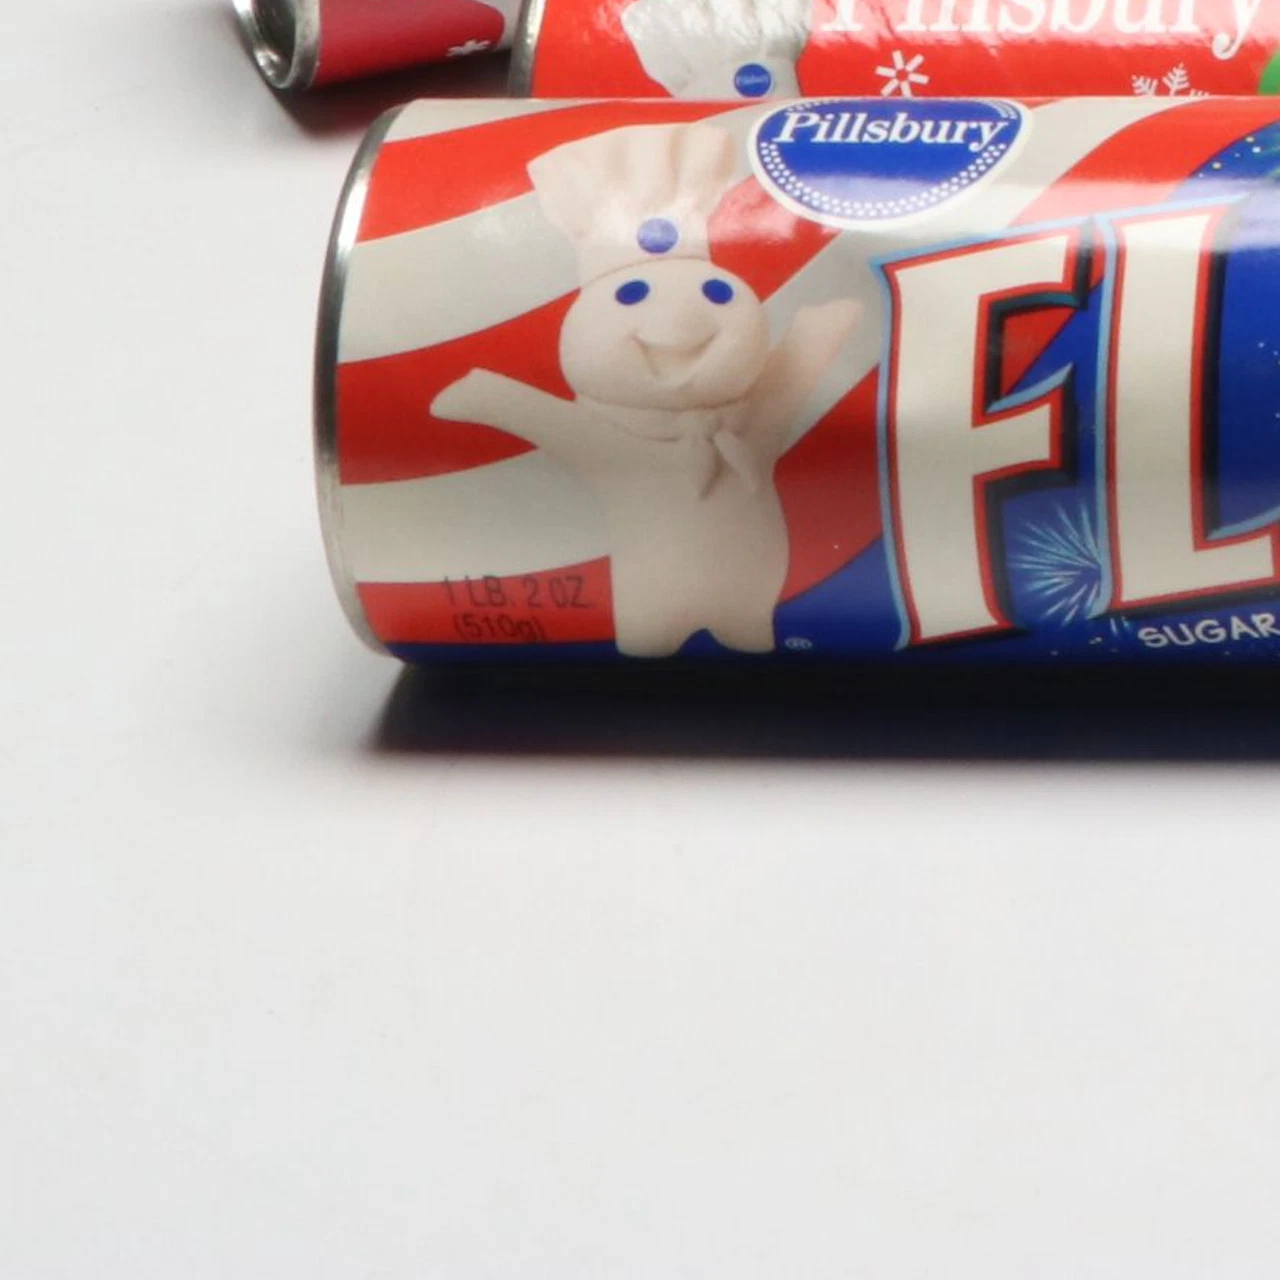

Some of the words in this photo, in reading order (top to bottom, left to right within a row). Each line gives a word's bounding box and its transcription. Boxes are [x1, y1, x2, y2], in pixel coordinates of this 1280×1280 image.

[771, 111, 1010, 153] Pillsbury
[521, 573, 543, 608] 2
[453, 611, 551, 645] (510g)
